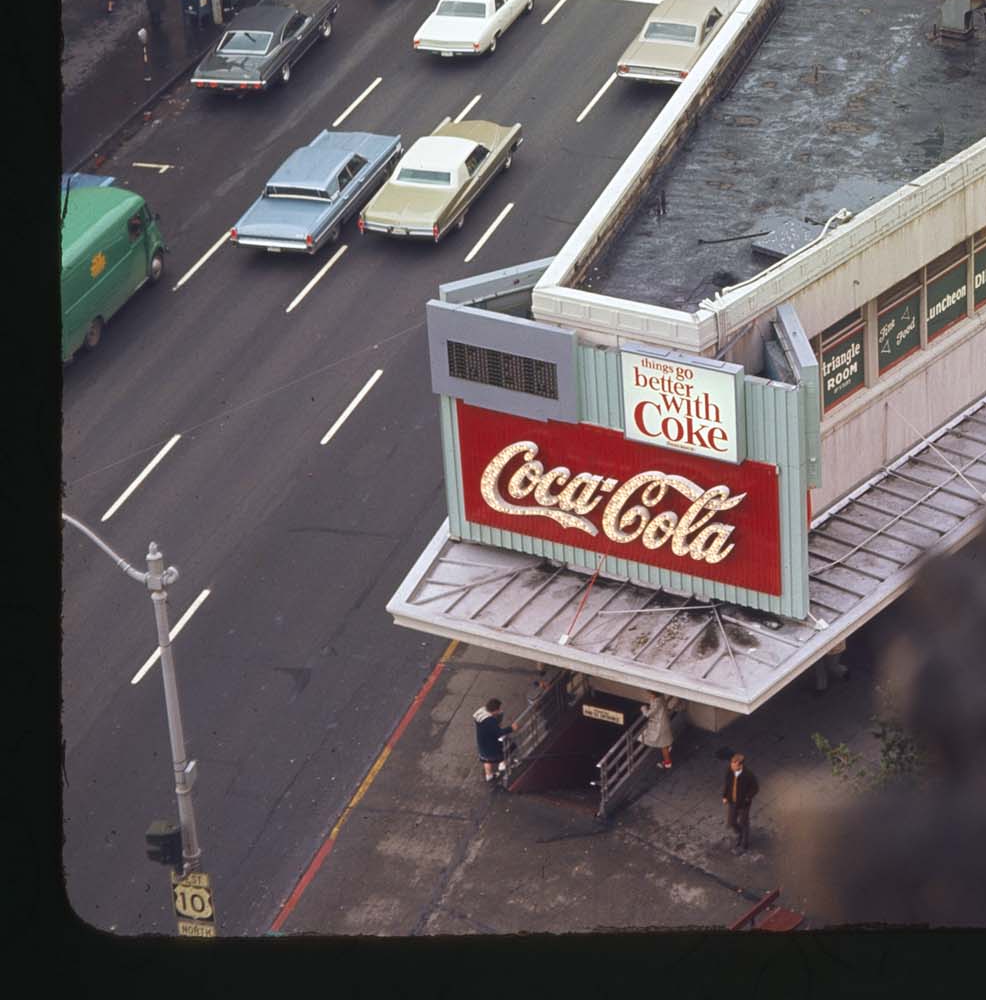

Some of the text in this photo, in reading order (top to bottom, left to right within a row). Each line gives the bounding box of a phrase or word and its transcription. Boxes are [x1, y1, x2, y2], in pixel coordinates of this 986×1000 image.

[926, 284, 967, 322] uncheon
[640, 358, 694, 381] things go
[822, 343, 861, 377] triangle
[827, 361, 858, 391] ROOM
[633, 366, 694, 398] better
[659, 392, 721, 424] with
[633, 400, 729, 452] Coke
[480, 440, 747, 565] Coca-Cola
[180, 892, 205, 913] 10
